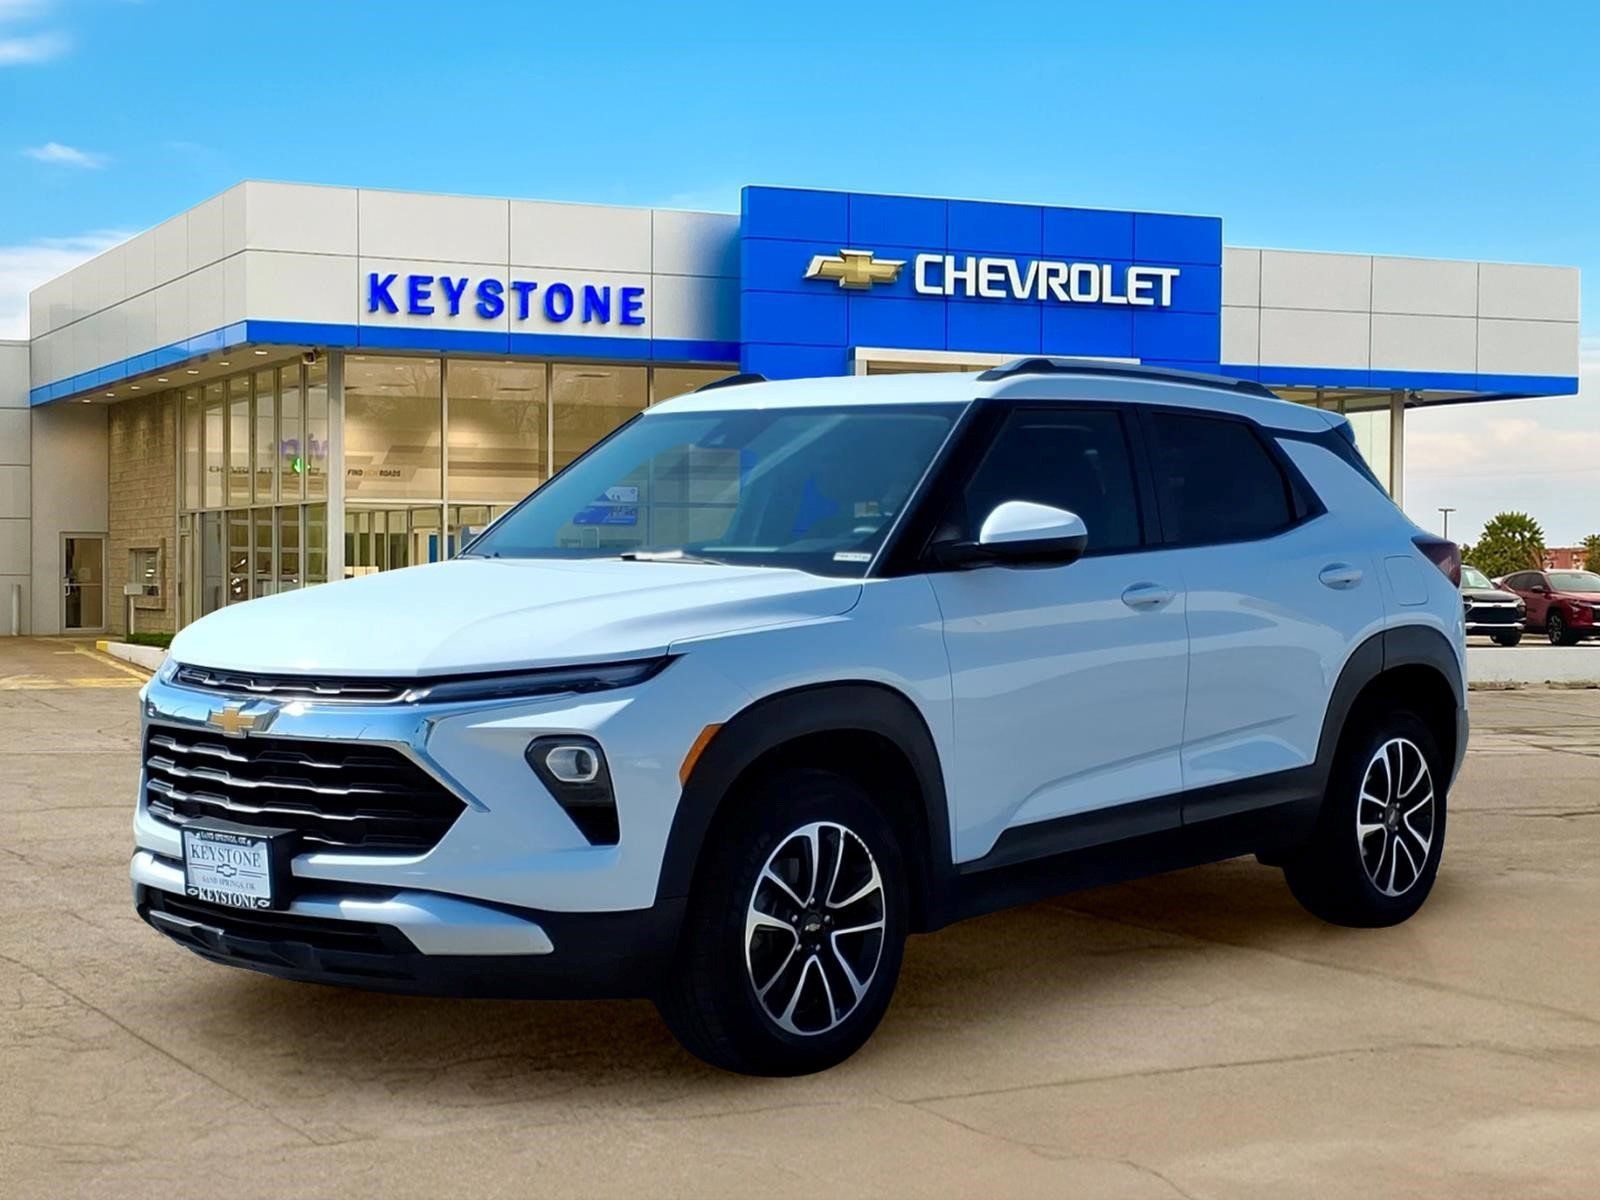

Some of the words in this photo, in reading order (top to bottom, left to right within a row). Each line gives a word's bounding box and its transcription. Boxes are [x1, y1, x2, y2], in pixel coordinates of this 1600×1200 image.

[915, 253, 1180, 307] CHEVROLET
[368, 272, 646, 326] KEYSTONE
[347, 468, 364, 477] FIND
[379, 469, 401, 478] ROADS
[191, 844, 261, 868] KEYSTONE
[198, 888, 258, 909] KEYSTONE
